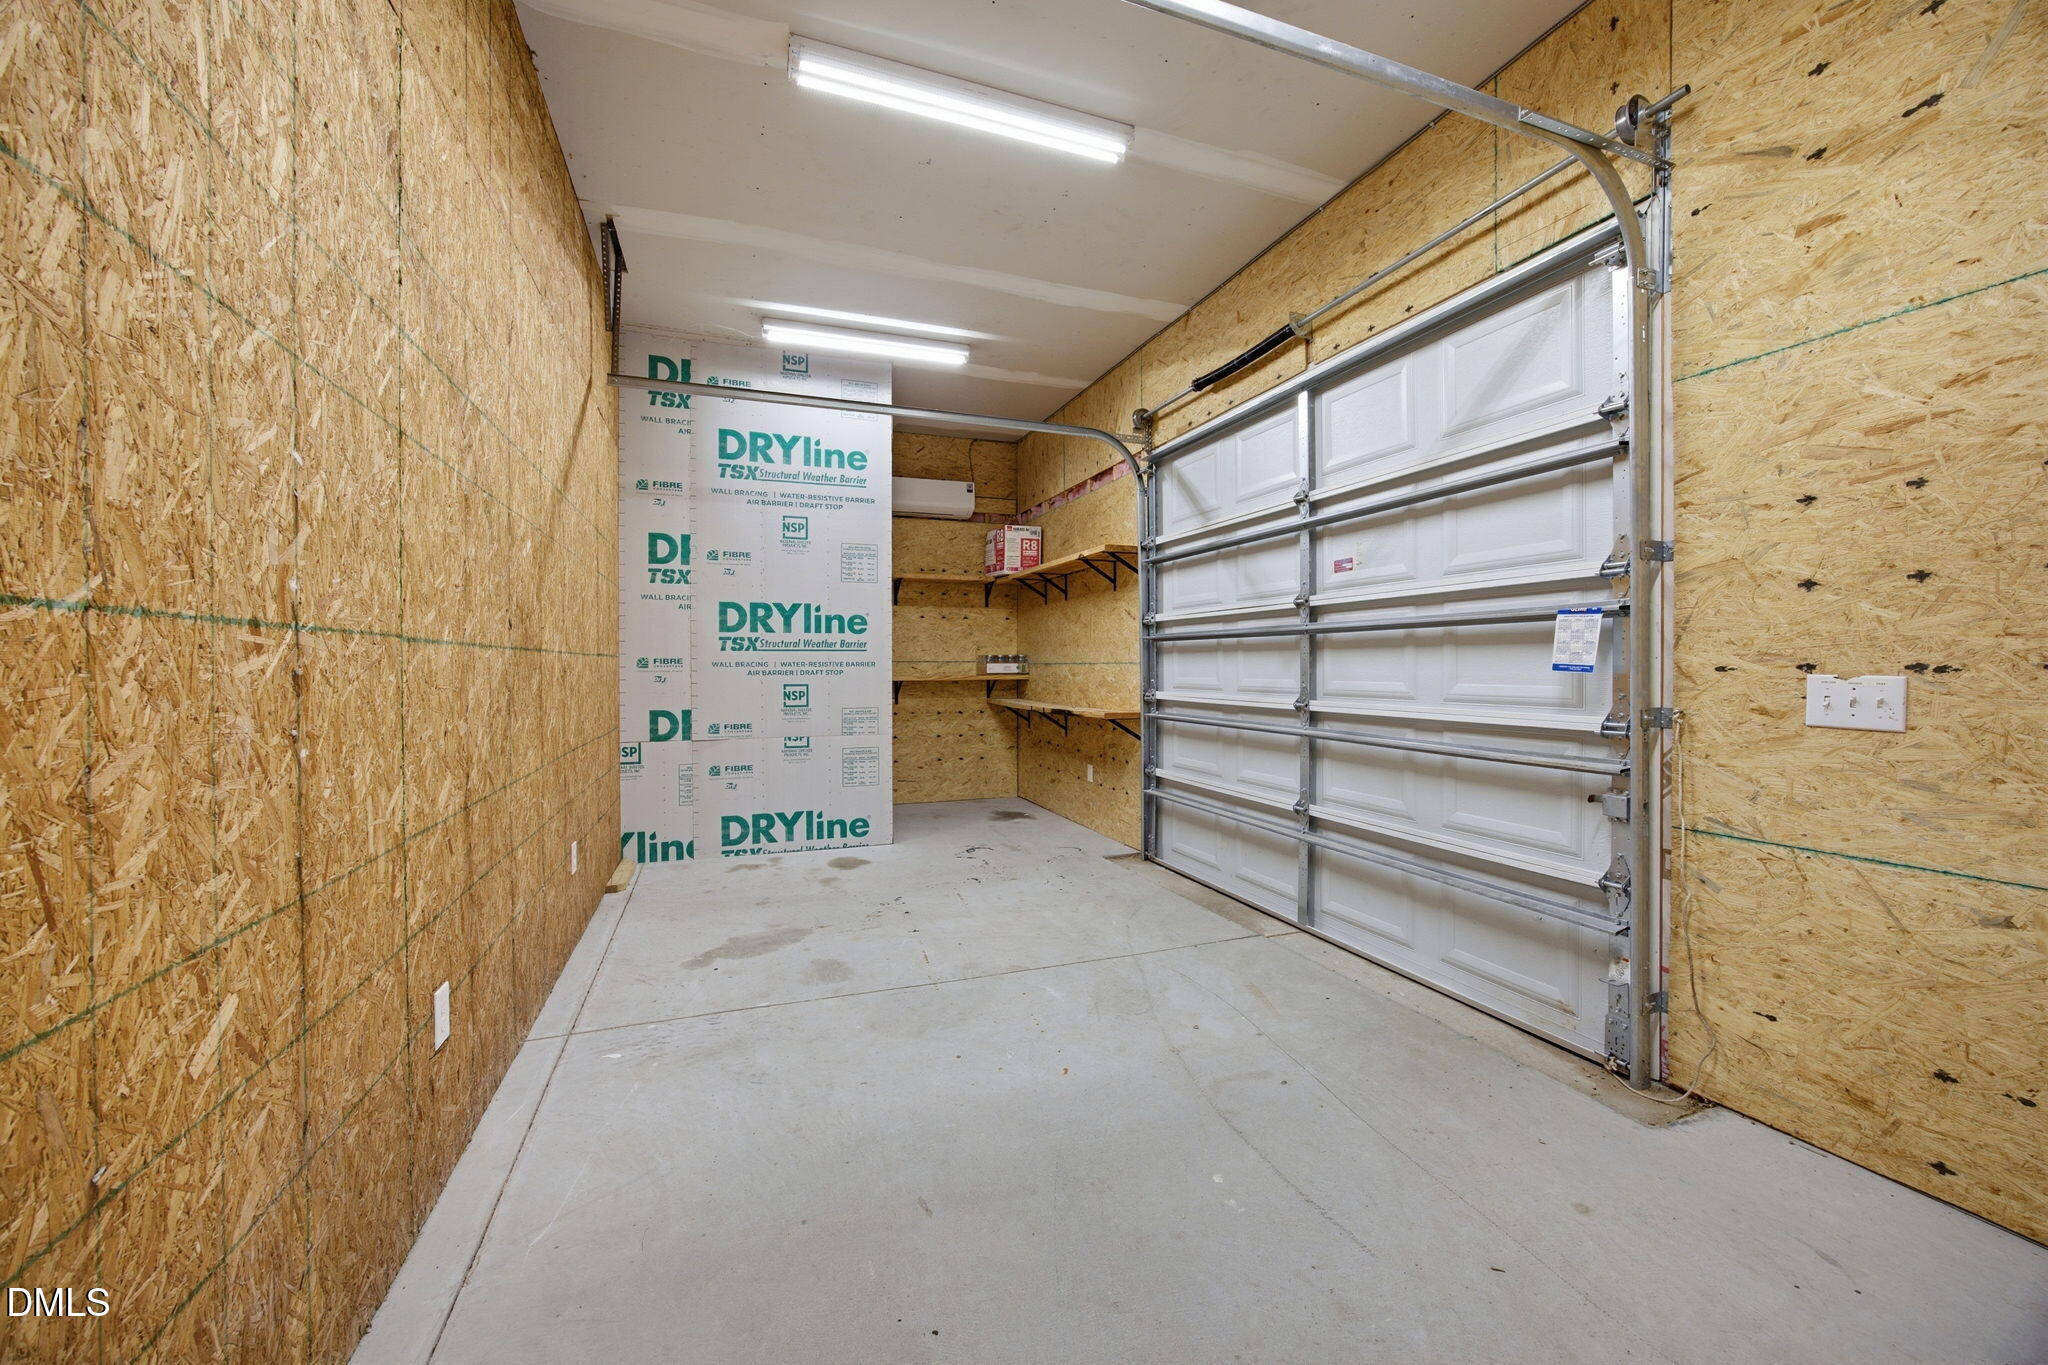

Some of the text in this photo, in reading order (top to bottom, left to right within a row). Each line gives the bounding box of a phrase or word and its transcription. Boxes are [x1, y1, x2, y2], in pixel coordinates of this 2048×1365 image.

[782, 354, 805, 366] NSP
[722, 378, 752, 388] FIBRE
[647, 390, 692, 410] TSX
[640, 415, 663, 424] WALL
[718, 427, 868, 471] DRYline
[717, 463, 867, 485] TSX Structural Weather Barrier
[652, 480, 683, 489] FIBRE
[710, 487, 876, 505] WALL BRACING WATER-RESISTIVE BARRIER
[746, 498, 760, 506] AIR
[761, 499, 794, 508] BARRIER
[799, 502, 823, 510] DRAFT
[782, 522, 805, 533] NSP
[1022, 540, 1038, 551] R8
[722, 551, 752, 559] FIBRE
[647, 567, 692, 585] TSX
[718, 601, 868, 635] DRYline
[718, 636, 868, 652] TSX Structural Weather Barrier
[783, 690, 806, 701] NSP
[720, 810, 871, 847] DRYline
